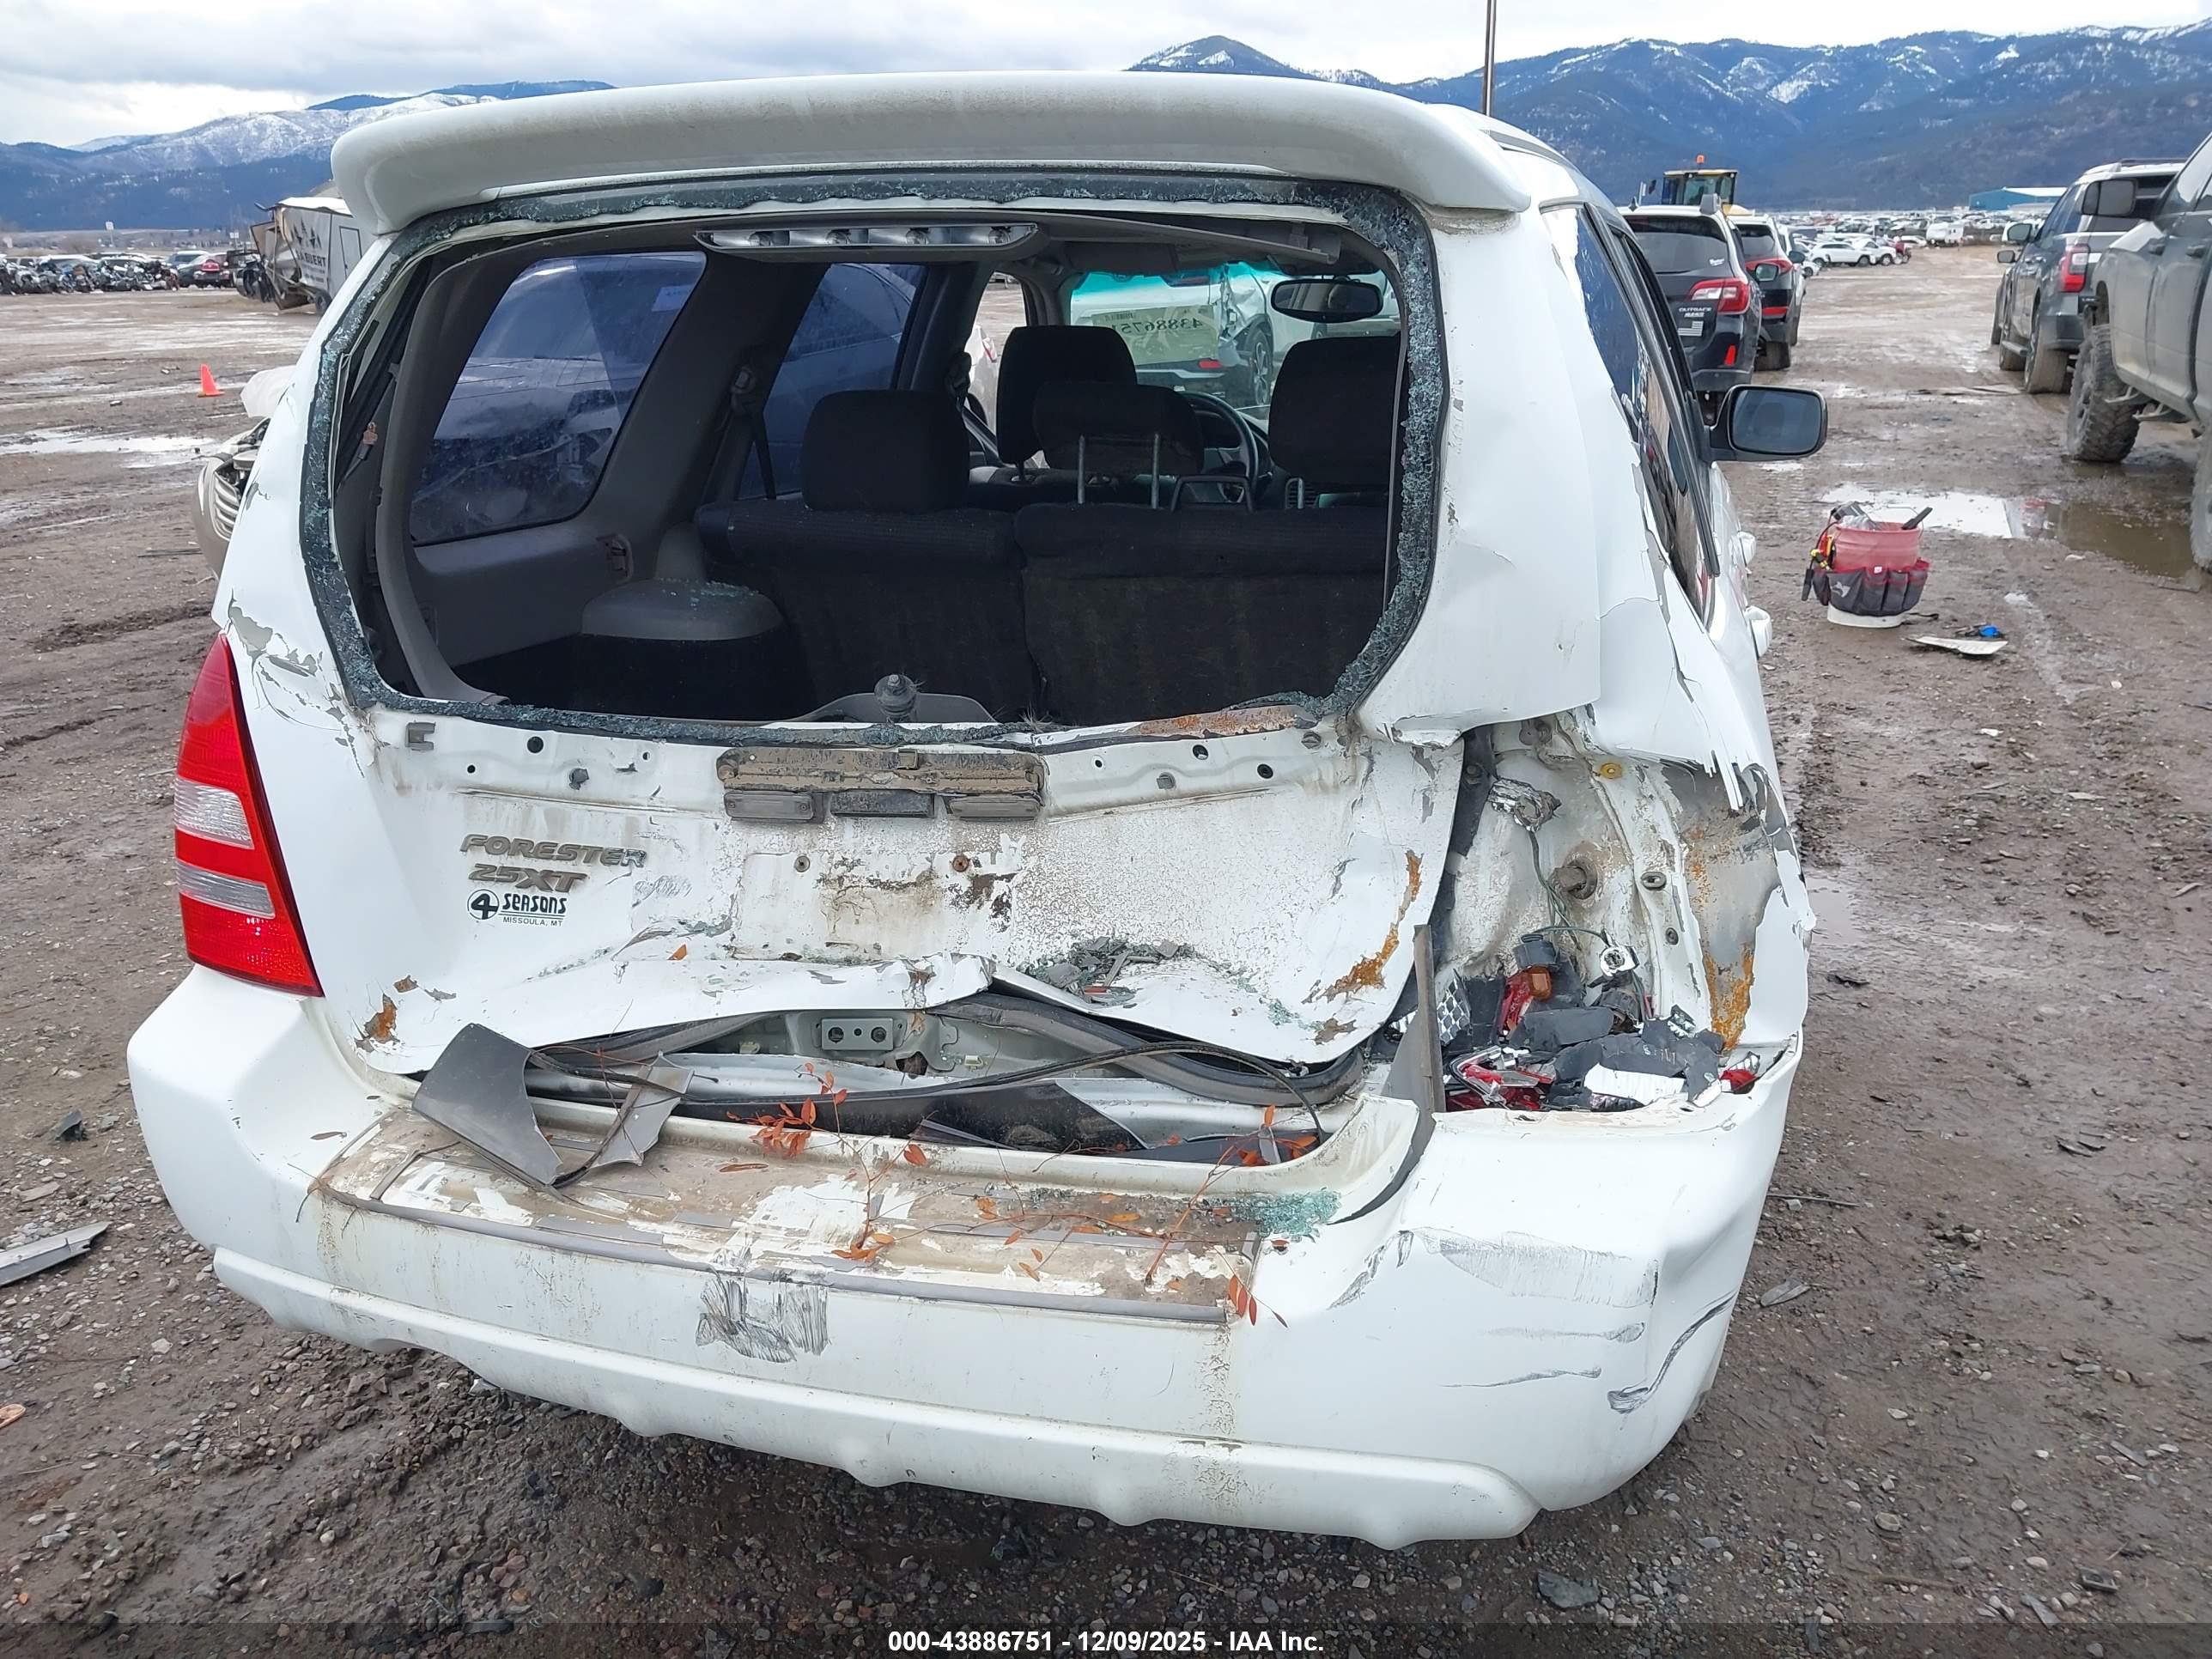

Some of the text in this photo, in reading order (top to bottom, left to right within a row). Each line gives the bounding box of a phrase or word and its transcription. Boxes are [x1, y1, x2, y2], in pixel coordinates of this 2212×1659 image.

[459, 834, 648, 867] FORESTER
[470, 893, 499, 920] 4
[503, 916, 548, 927] MISSOULA,
